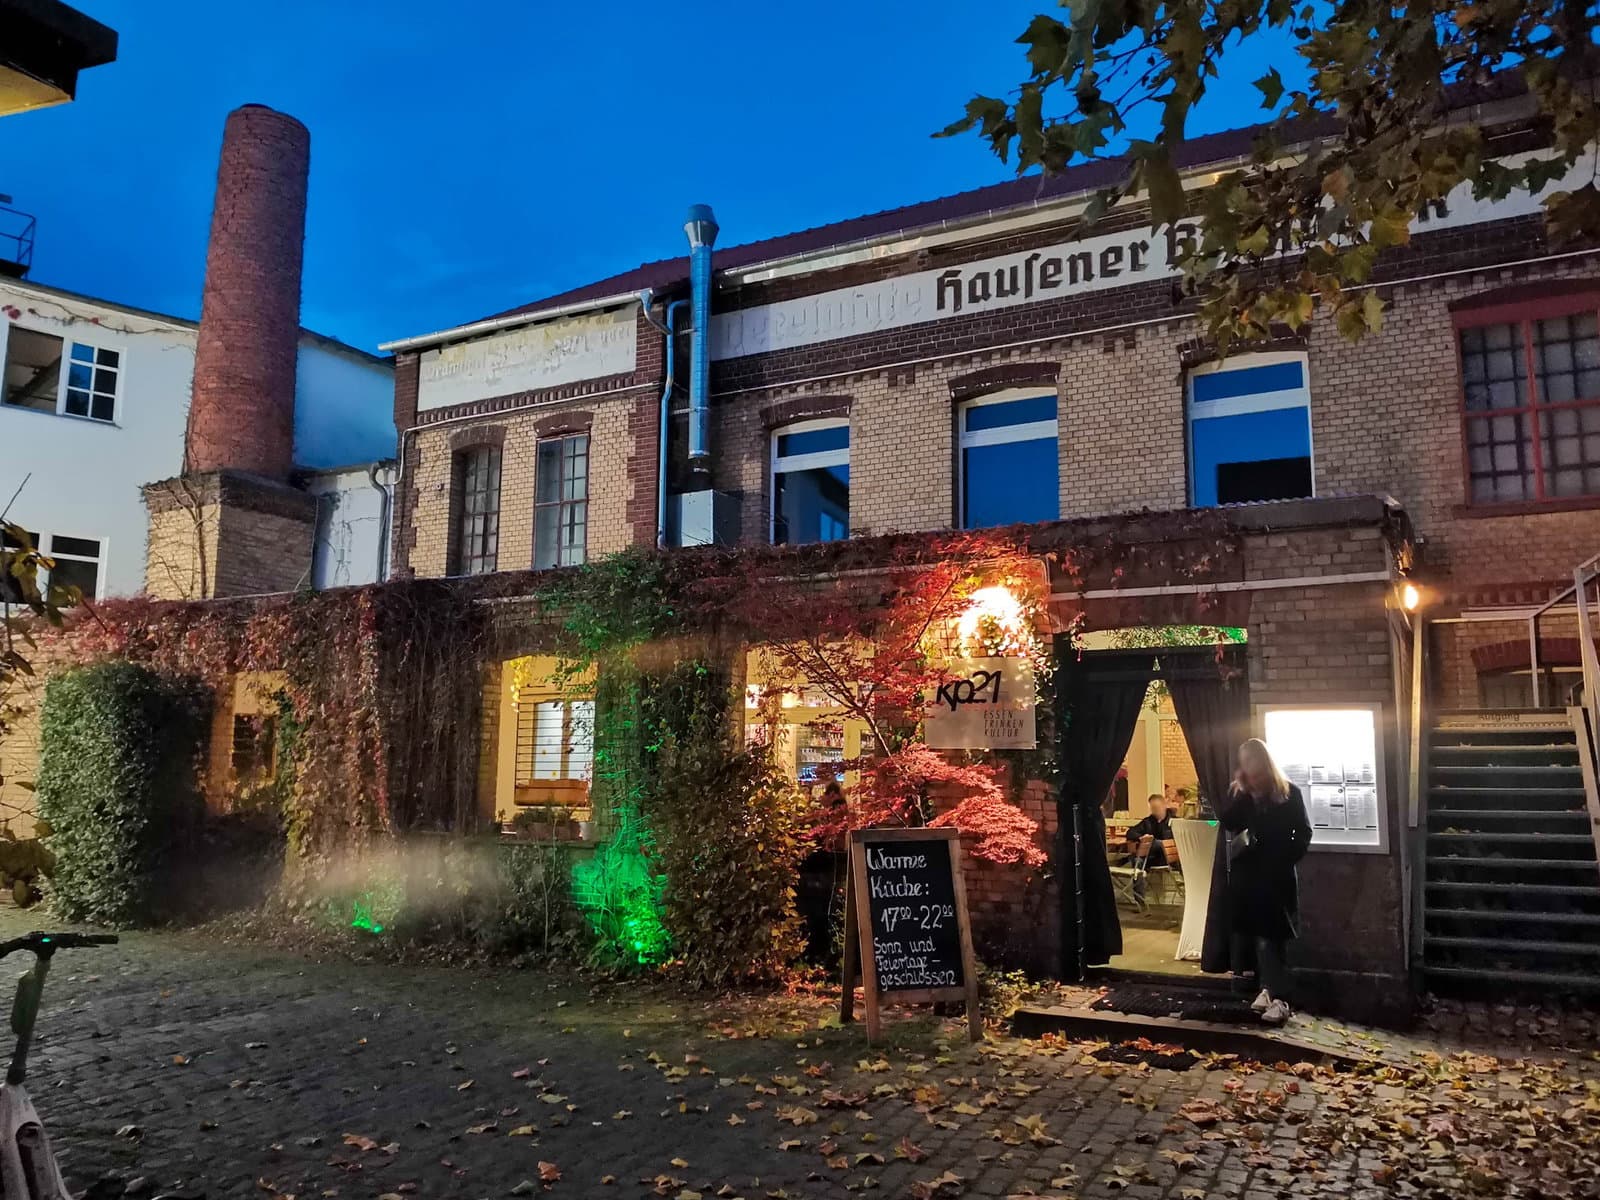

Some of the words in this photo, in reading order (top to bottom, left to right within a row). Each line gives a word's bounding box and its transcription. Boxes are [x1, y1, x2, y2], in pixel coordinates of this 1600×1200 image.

[983, 709, 1013, 720] ESSEN
[984, 719, 1024, 729] TRINKEN
[984, 728, 1019, 738] KULTUR
[866, 848, 927, 870] Warme
[870, 875, 929, 899] Küche:
[874, 937, 902, 954] Sonn
[909, 936, 937, 953] und
[875, 955, 928, 973] Feiertage
[880, 969, 957, 992] geschlossen
